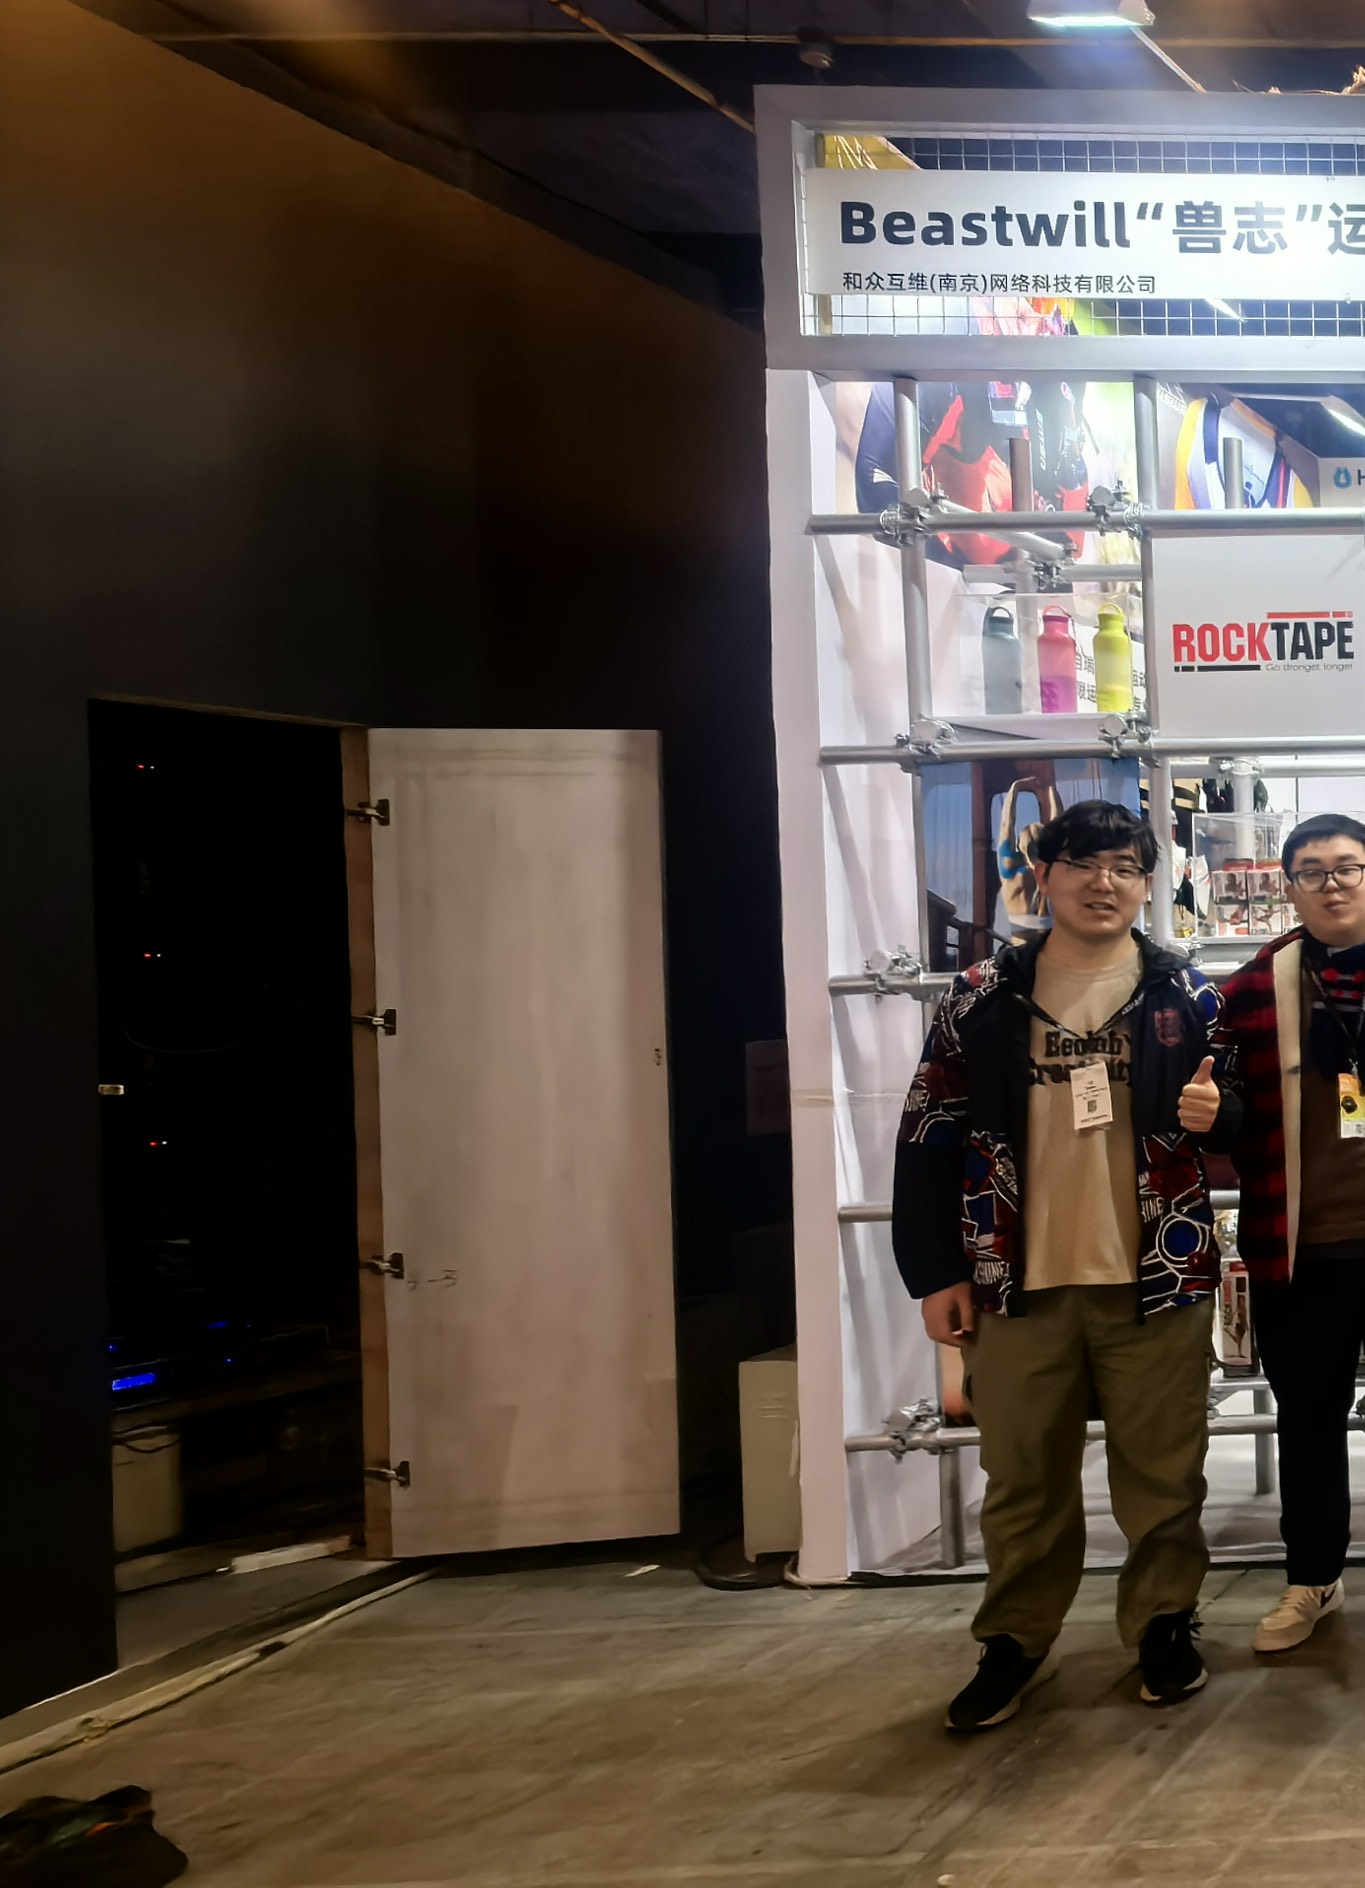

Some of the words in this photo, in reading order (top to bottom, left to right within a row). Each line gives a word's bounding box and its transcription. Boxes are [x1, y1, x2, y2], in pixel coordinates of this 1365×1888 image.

[842, 271, 1157, 294] 和众互维(南京)网络科技有限公司
[1172, 621, 1355, 663] ROCKTAPE
